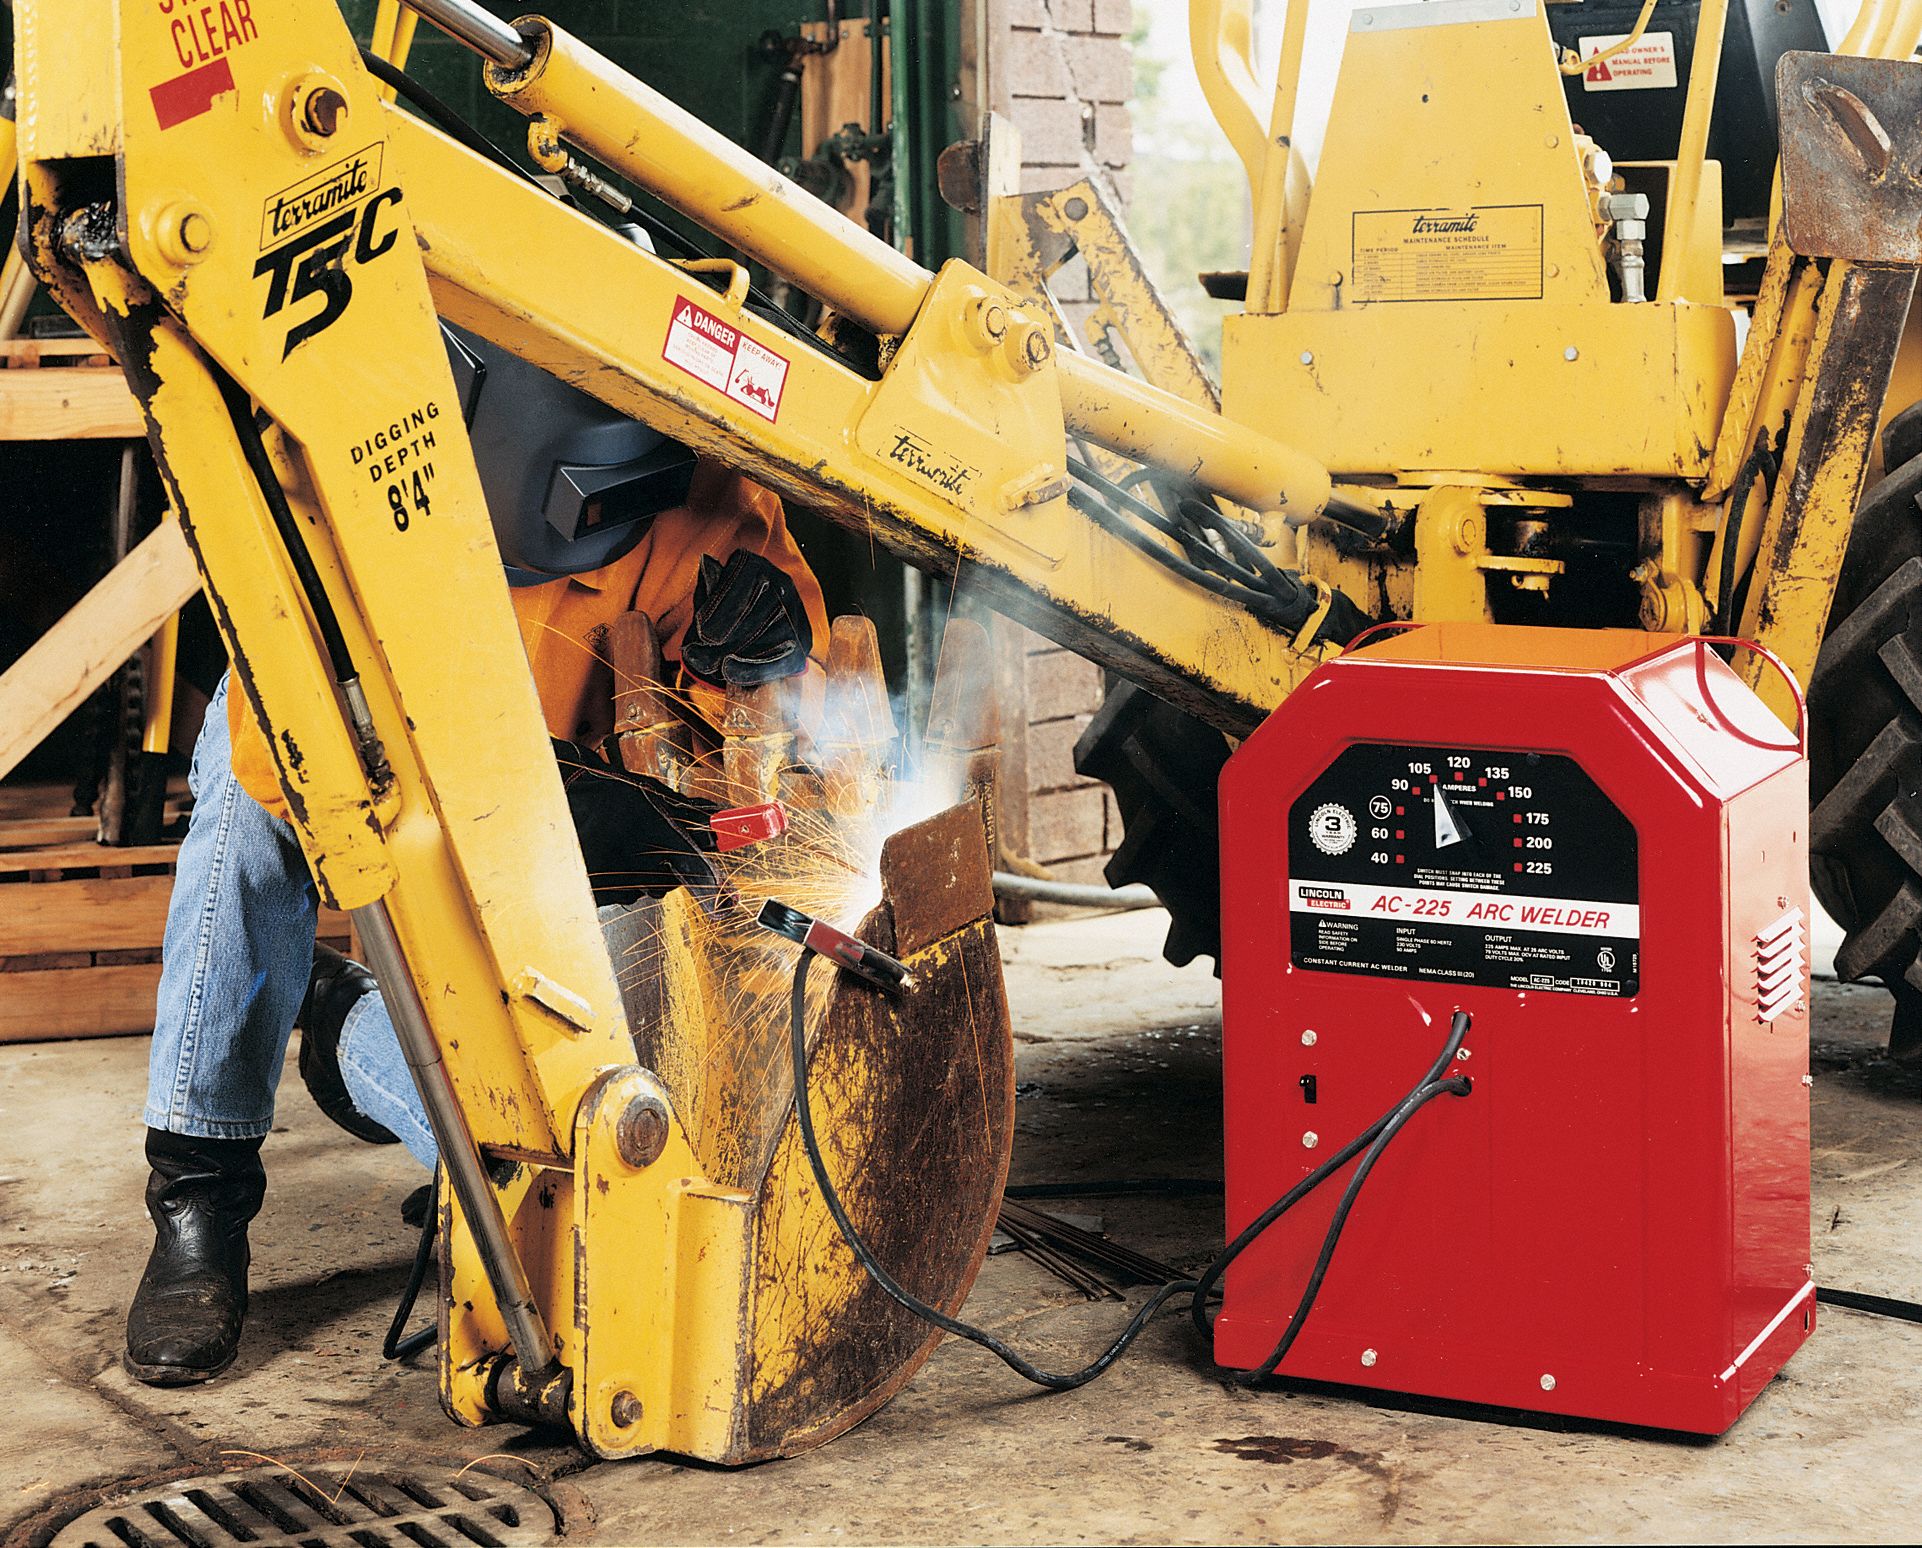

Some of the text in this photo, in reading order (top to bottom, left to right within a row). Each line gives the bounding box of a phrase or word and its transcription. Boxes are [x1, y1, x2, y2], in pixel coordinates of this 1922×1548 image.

[171, 0, 258, 68] CLEAR
[267, 158, 368, 236] terramite
[1413, 213, 1480, 234] terramite
[693, 311, 736, 348] DANGER
[742, 342, 761, 356] KEEP
[350, 402, 440, 464] DIGGING
[369, 431, 436, 483] DEPTH
[1408, 762, 1432, 774] 105
[1447, 756, 1471, 768] 120
[1484, 767, 1510, 779] 135
[1391, 779, 1408, 791] 90
[1442, 784, 1476, 792] AMPERES
[1508, 786, 1532, 798] 150
[1373, 802, 1389, 812] 75
[1315, 810, 1331, 828] LINCOLN
[1325, 816, 1341, 832] 3
[1526, 812, 1550, 825] 175
[1371, 828, 1388, 839] 60
[1526, 838, 1552, 850] 200
[1370, 852, 1388, 864] 40
[1526, 862, 1552, 874] 225
[1300, 888, 1342, 900] LINCOLN
[1310, 900, 1347, 908] ELECTRIC
[1371, 896, 1610, 928] AC-225 ARC WELDER
[1326, 922, 1358, 930] WARNING
[1304, 957, 1337, 966] CONSTANT
